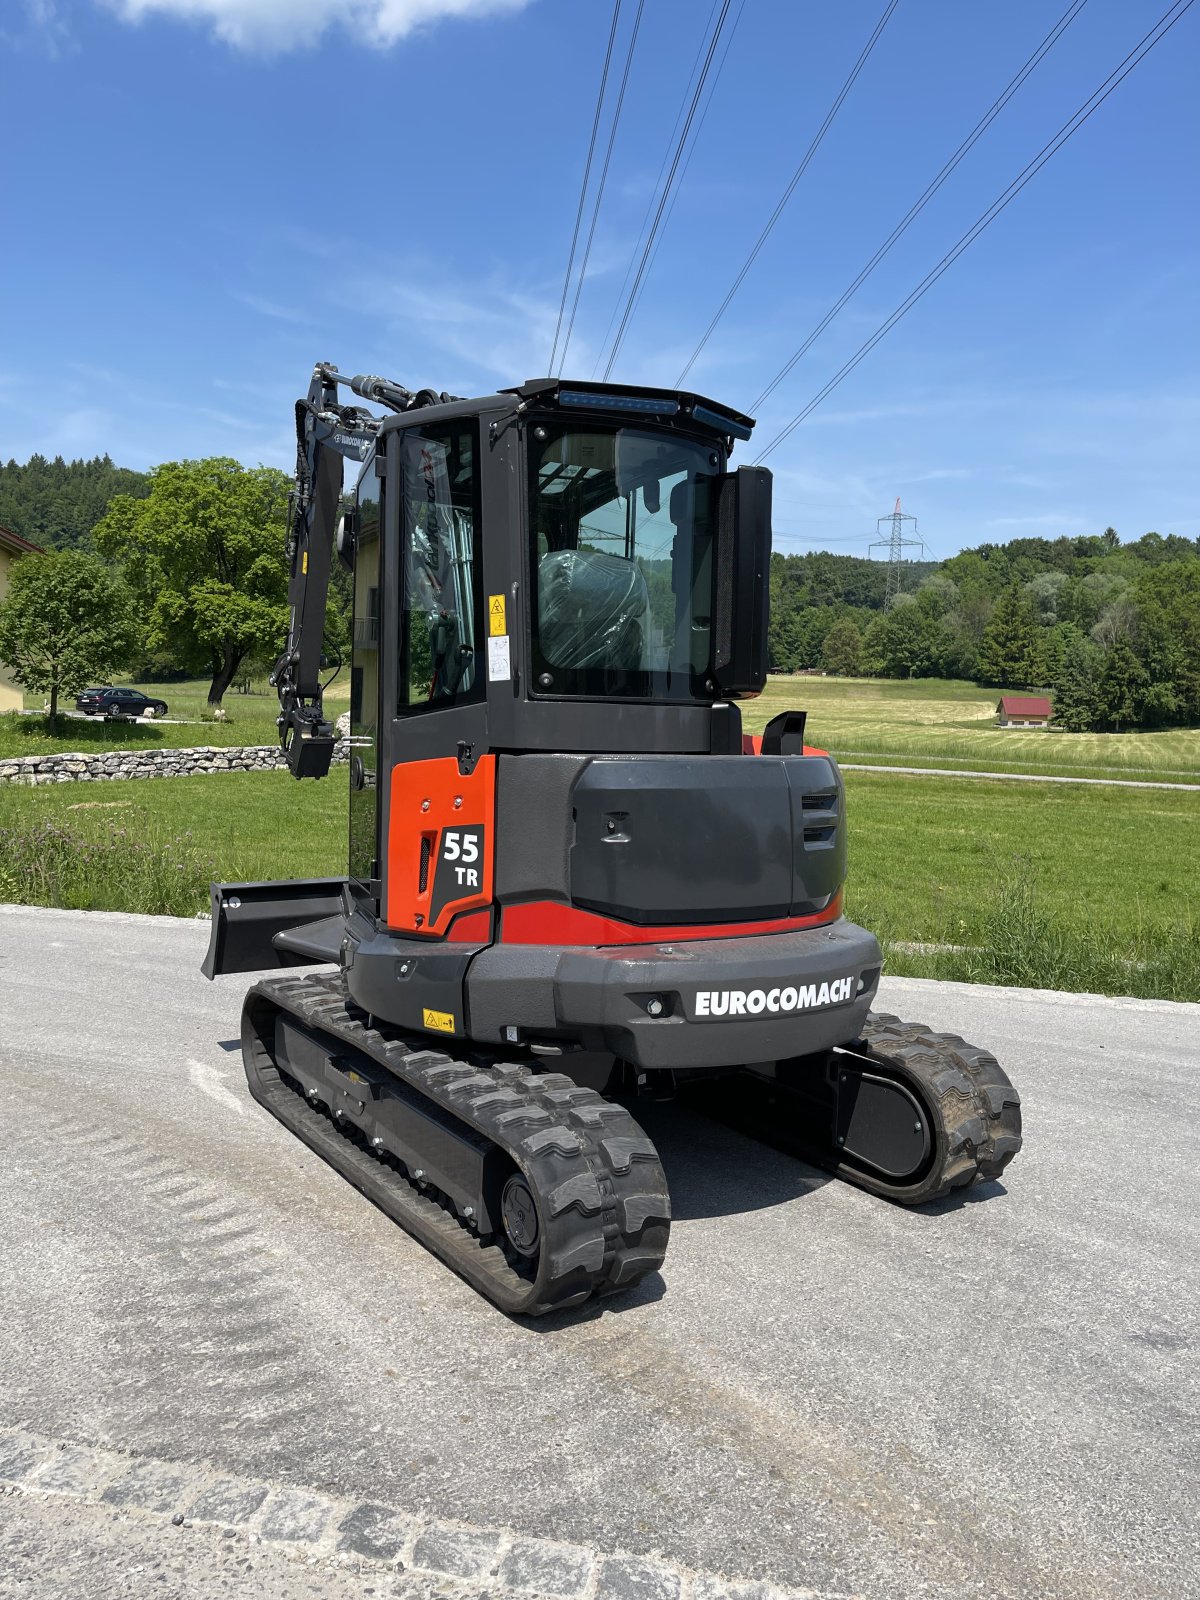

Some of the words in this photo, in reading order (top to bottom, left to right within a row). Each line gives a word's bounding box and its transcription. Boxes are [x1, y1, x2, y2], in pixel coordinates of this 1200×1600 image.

[443, 831, 479, 863] 55
[454, 866, 478, 887] TR
[695, 976, 852, 1016] EUROCOMACH
